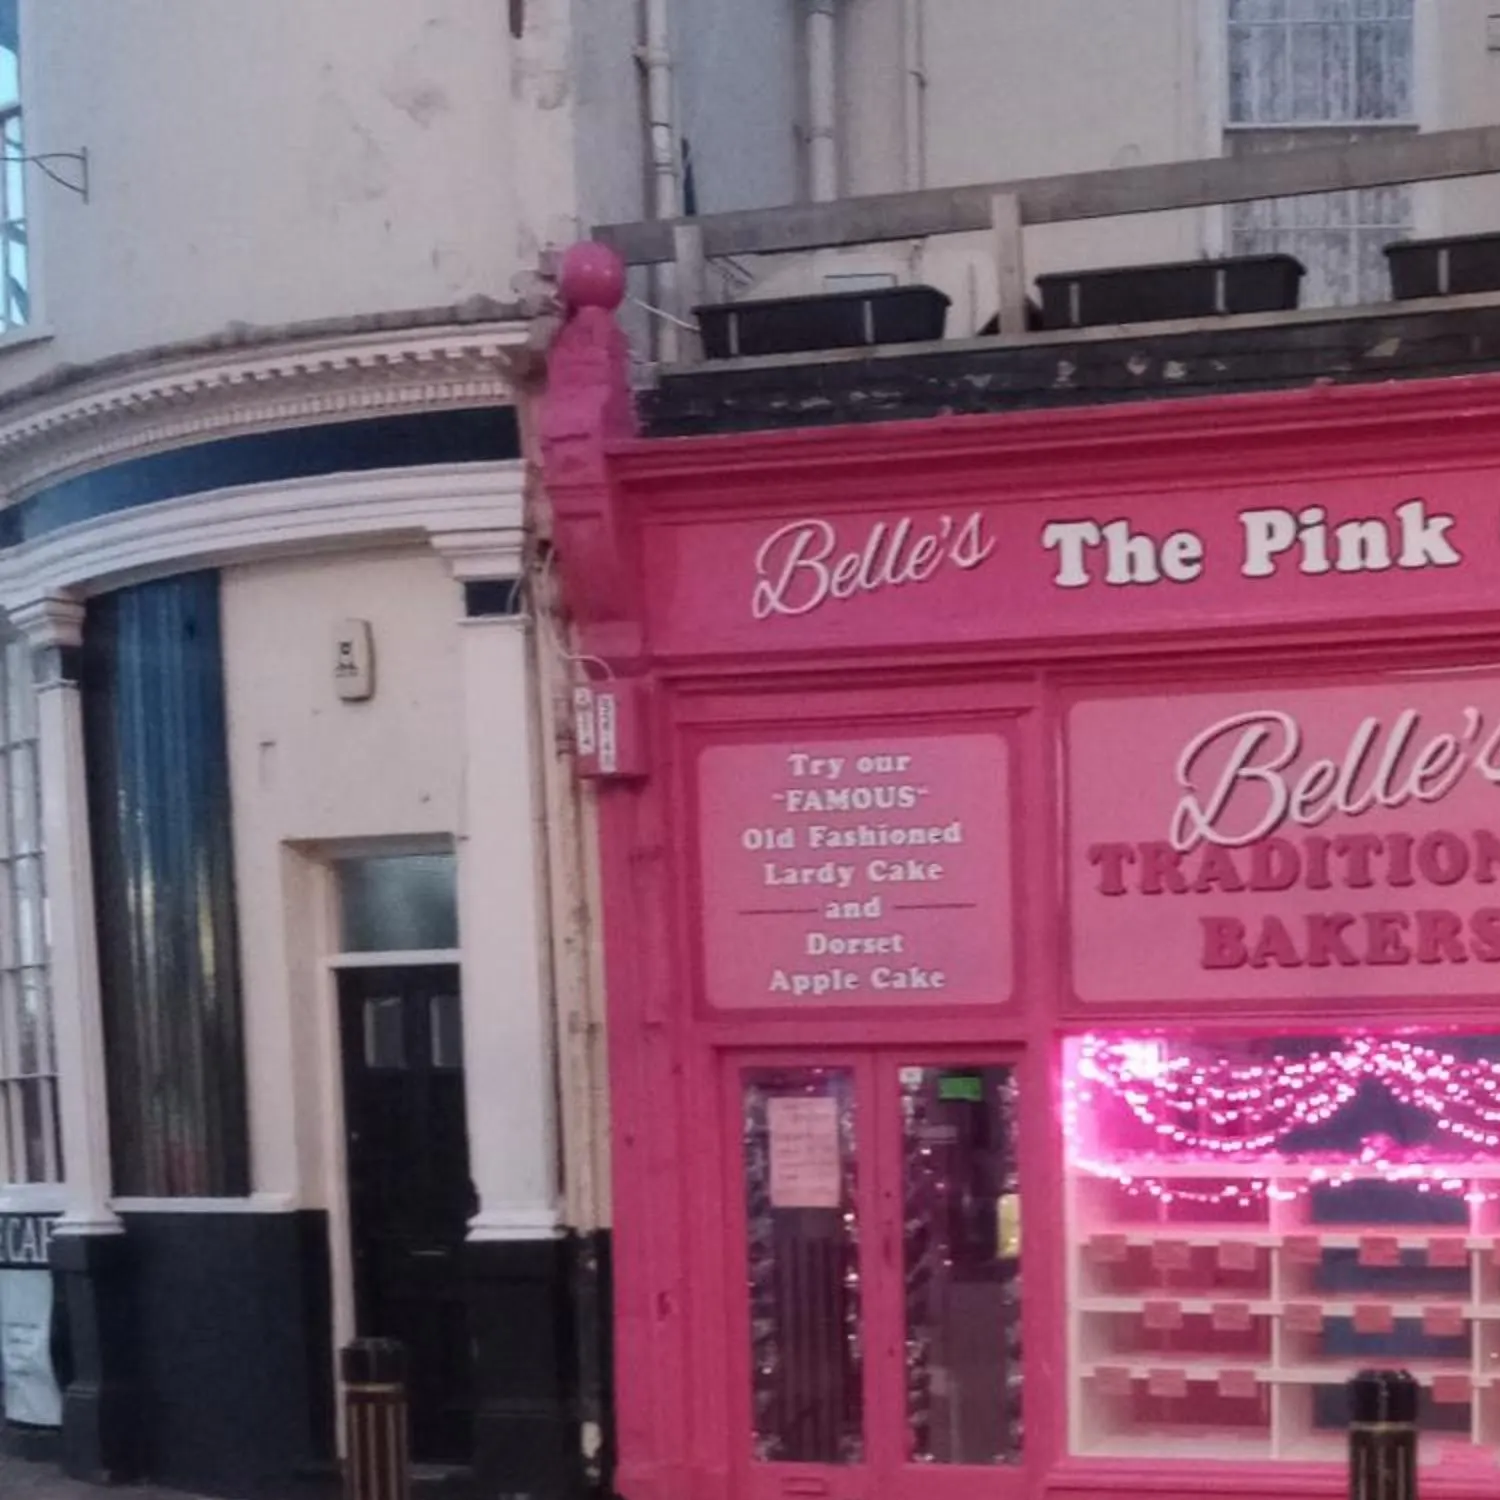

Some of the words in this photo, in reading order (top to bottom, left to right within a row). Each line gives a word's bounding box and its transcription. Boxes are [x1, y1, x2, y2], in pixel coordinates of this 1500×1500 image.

[752, 511, 996, 619] Belle's
[1042, 518, 1204, 588] The
[1239, 499, 1461, 578] Pink
[788, 753, 846, 780] Try
[857, 754, 912, 773] our
[742, 829, 796, 851] Old
[809, 822, 963, 849] Fashioned
[763, 863, 855, 888] Lardy
[867, 859, 945, 884] Cake
[824, 897, 882, 920] and
[806, 931, 905, 956] Dorset
[768, 970, 861, 996] Apple
[871, 966, 947, 989] Cake
